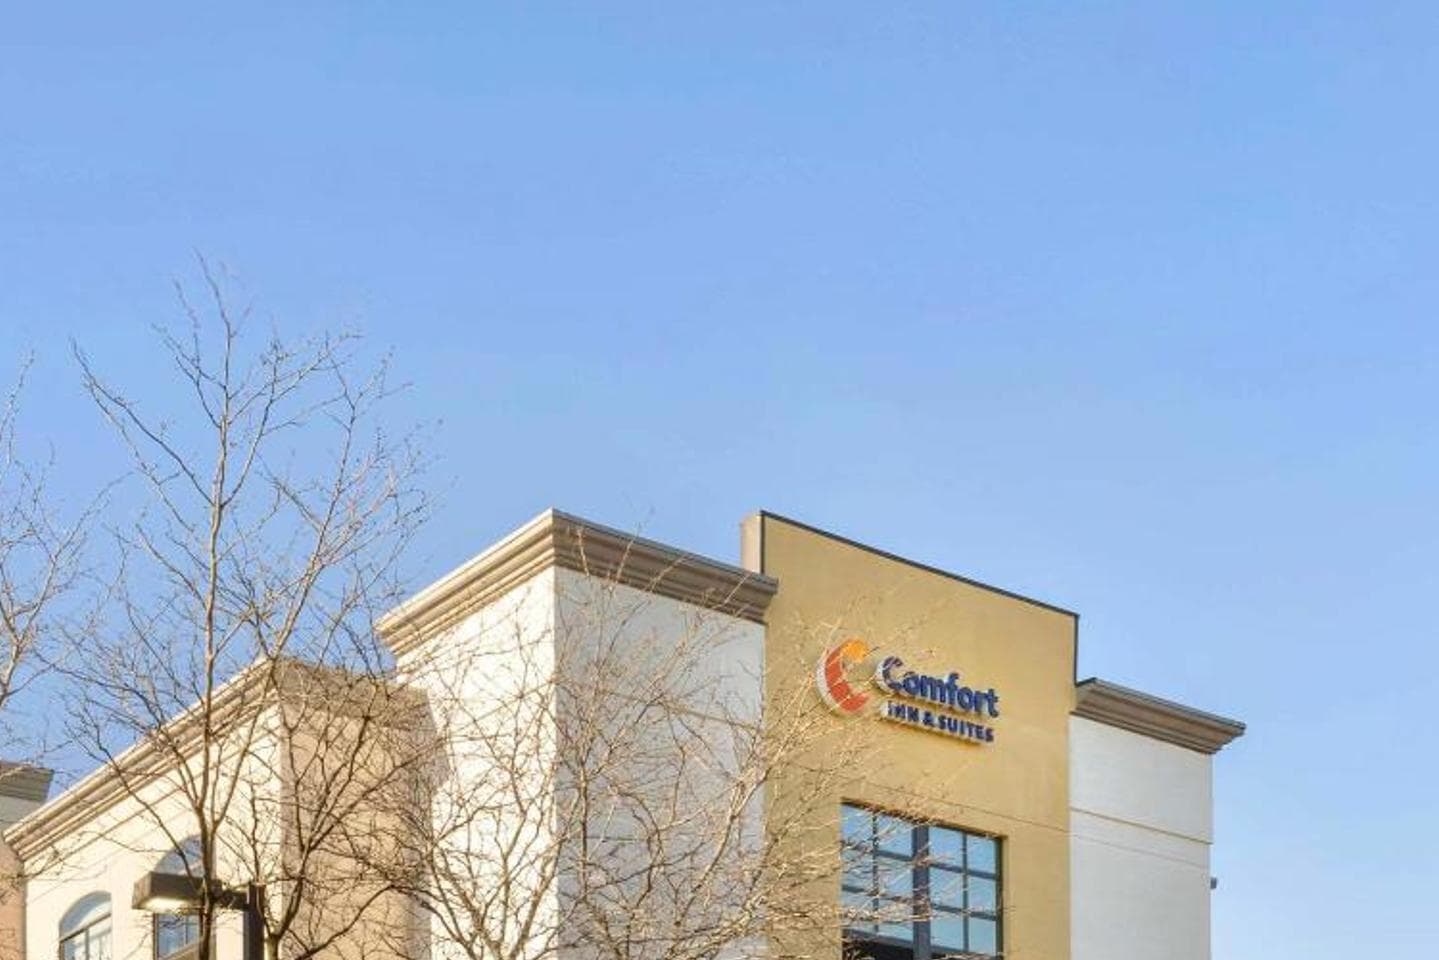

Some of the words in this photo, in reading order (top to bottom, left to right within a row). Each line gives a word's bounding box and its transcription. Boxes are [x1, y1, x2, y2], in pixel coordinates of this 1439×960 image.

[880, 655, 999, 719] Comfort
[887, 699, 920, 723] INN
[922, 711, 936, 728] &
[938, 714, 994, 743] SUITES
